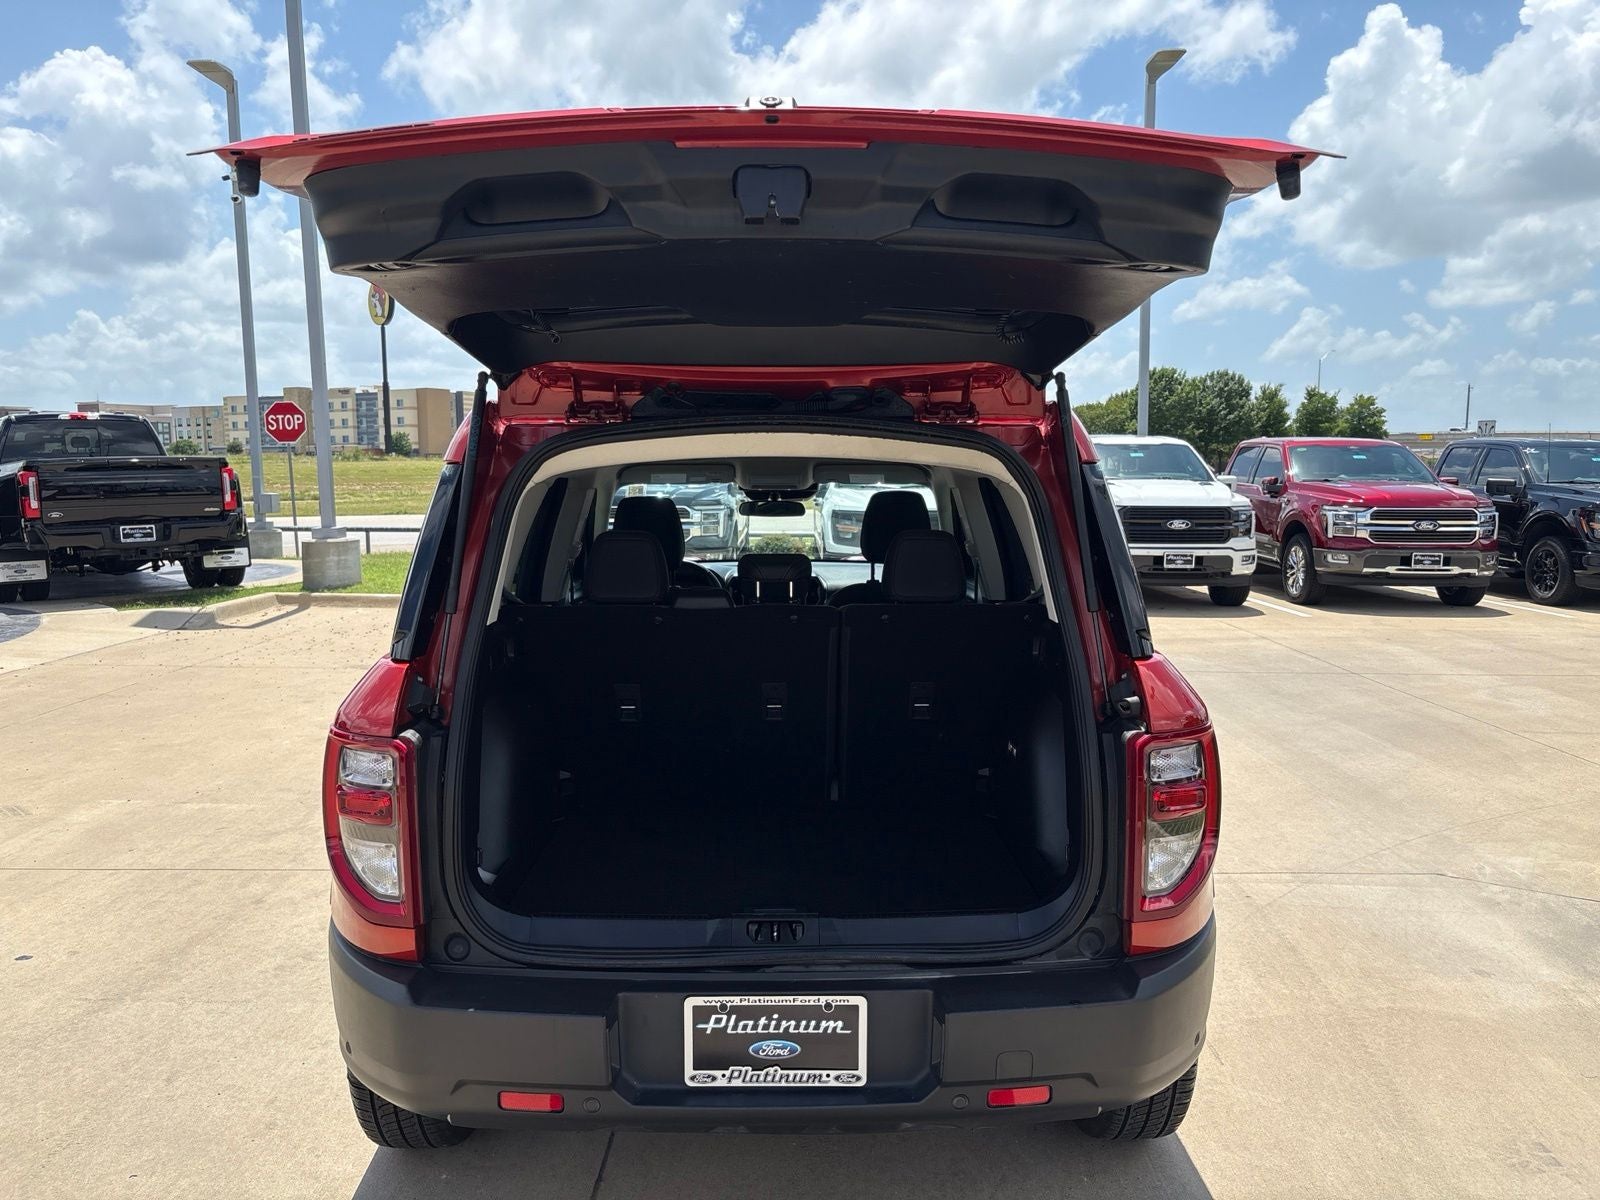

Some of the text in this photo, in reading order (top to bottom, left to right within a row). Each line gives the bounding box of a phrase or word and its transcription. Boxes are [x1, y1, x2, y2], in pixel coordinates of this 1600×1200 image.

[268, 414, 303, 430] STOP
[703, 997, 850, 1005] www.PlatinumFord.com
[696, 1013, 852, 1034] Platinum
[759, 1042, 791, 1056] Ford
[723, 1067, 831, 1084] Platinum
